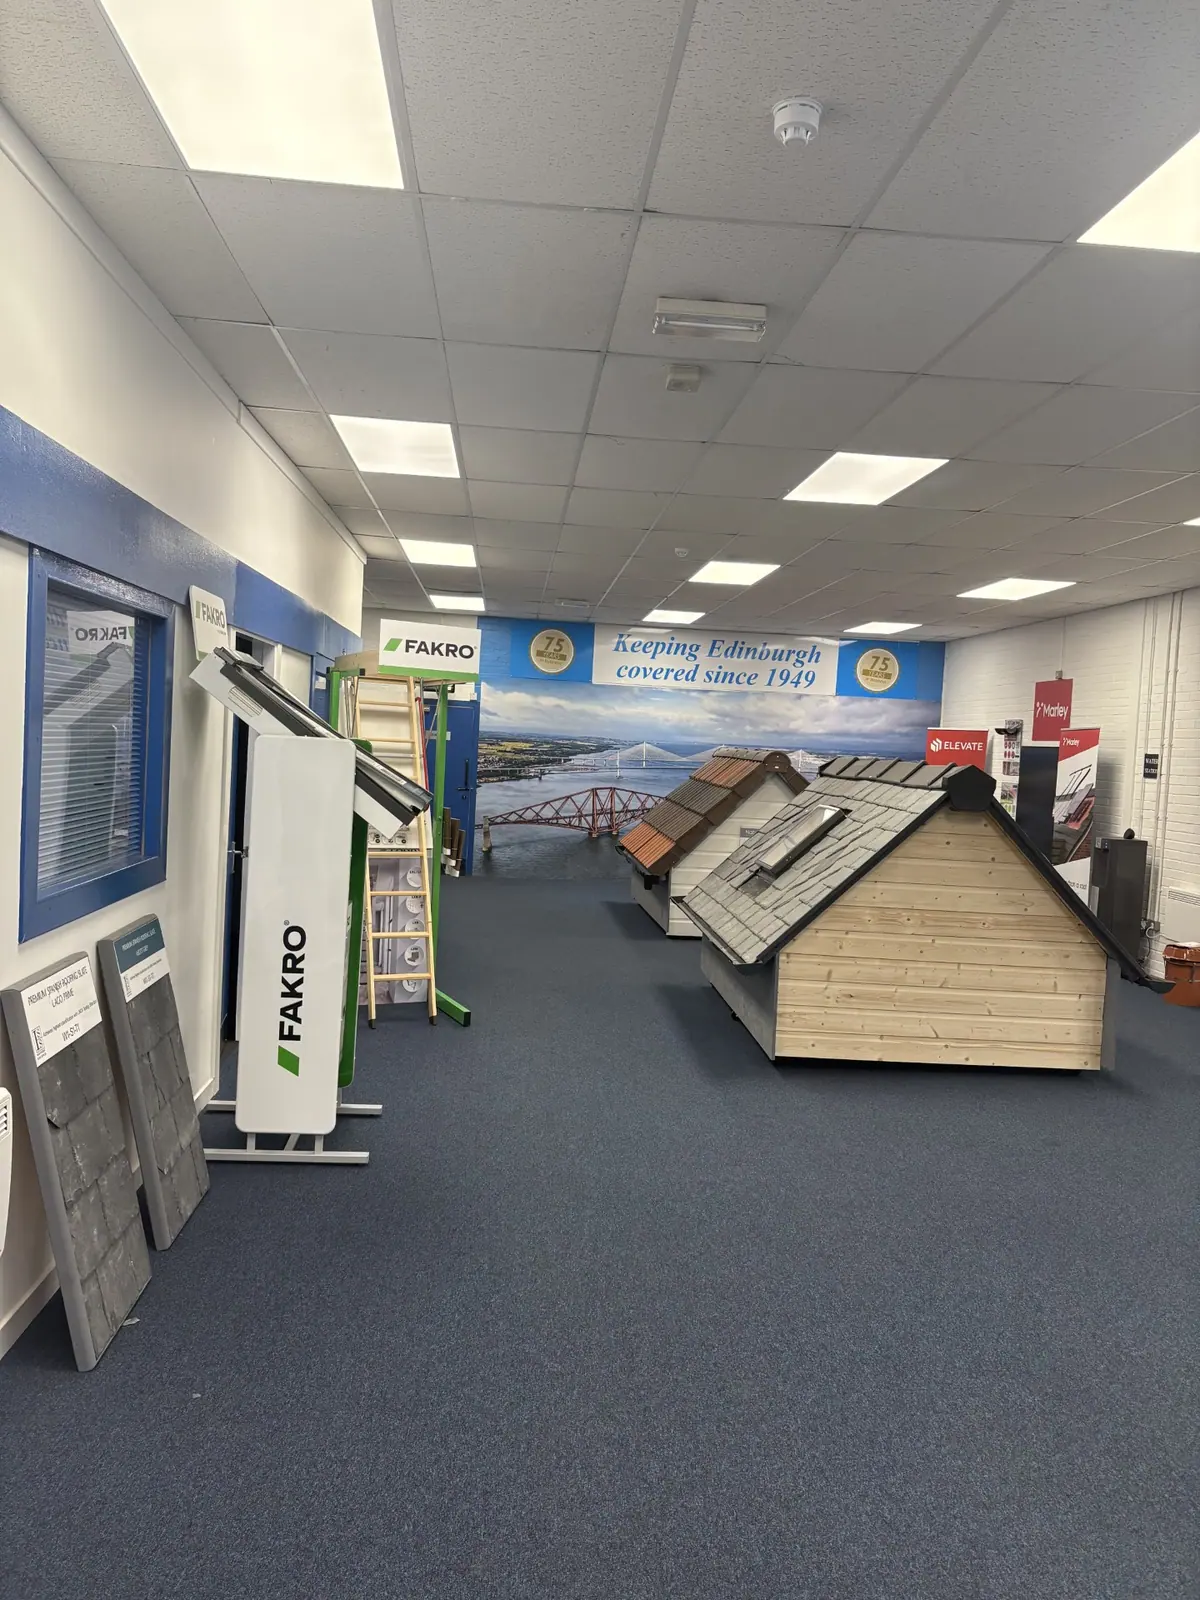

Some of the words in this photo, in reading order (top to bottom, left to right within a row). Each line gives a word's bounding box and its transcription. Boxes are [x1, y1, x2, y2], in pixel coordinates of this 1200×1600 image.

[202, 603, 226, 628] FAKRO
[404, 639, 474, 659] FAKRO
[544, 636, 565, 652] 75
[612, 633, 701, 662] Keeping
[706, 639, 822, 668] Edinburgh
[870, 656, 890, 672] 75
[616, 664, 700, 682] covered
[703, 665, 759, 686] since
[764, 668, 816, 688] 1949
[1043, 702, 1068, 720] Marley
[944, 741, 983, 751] ELEVATE
